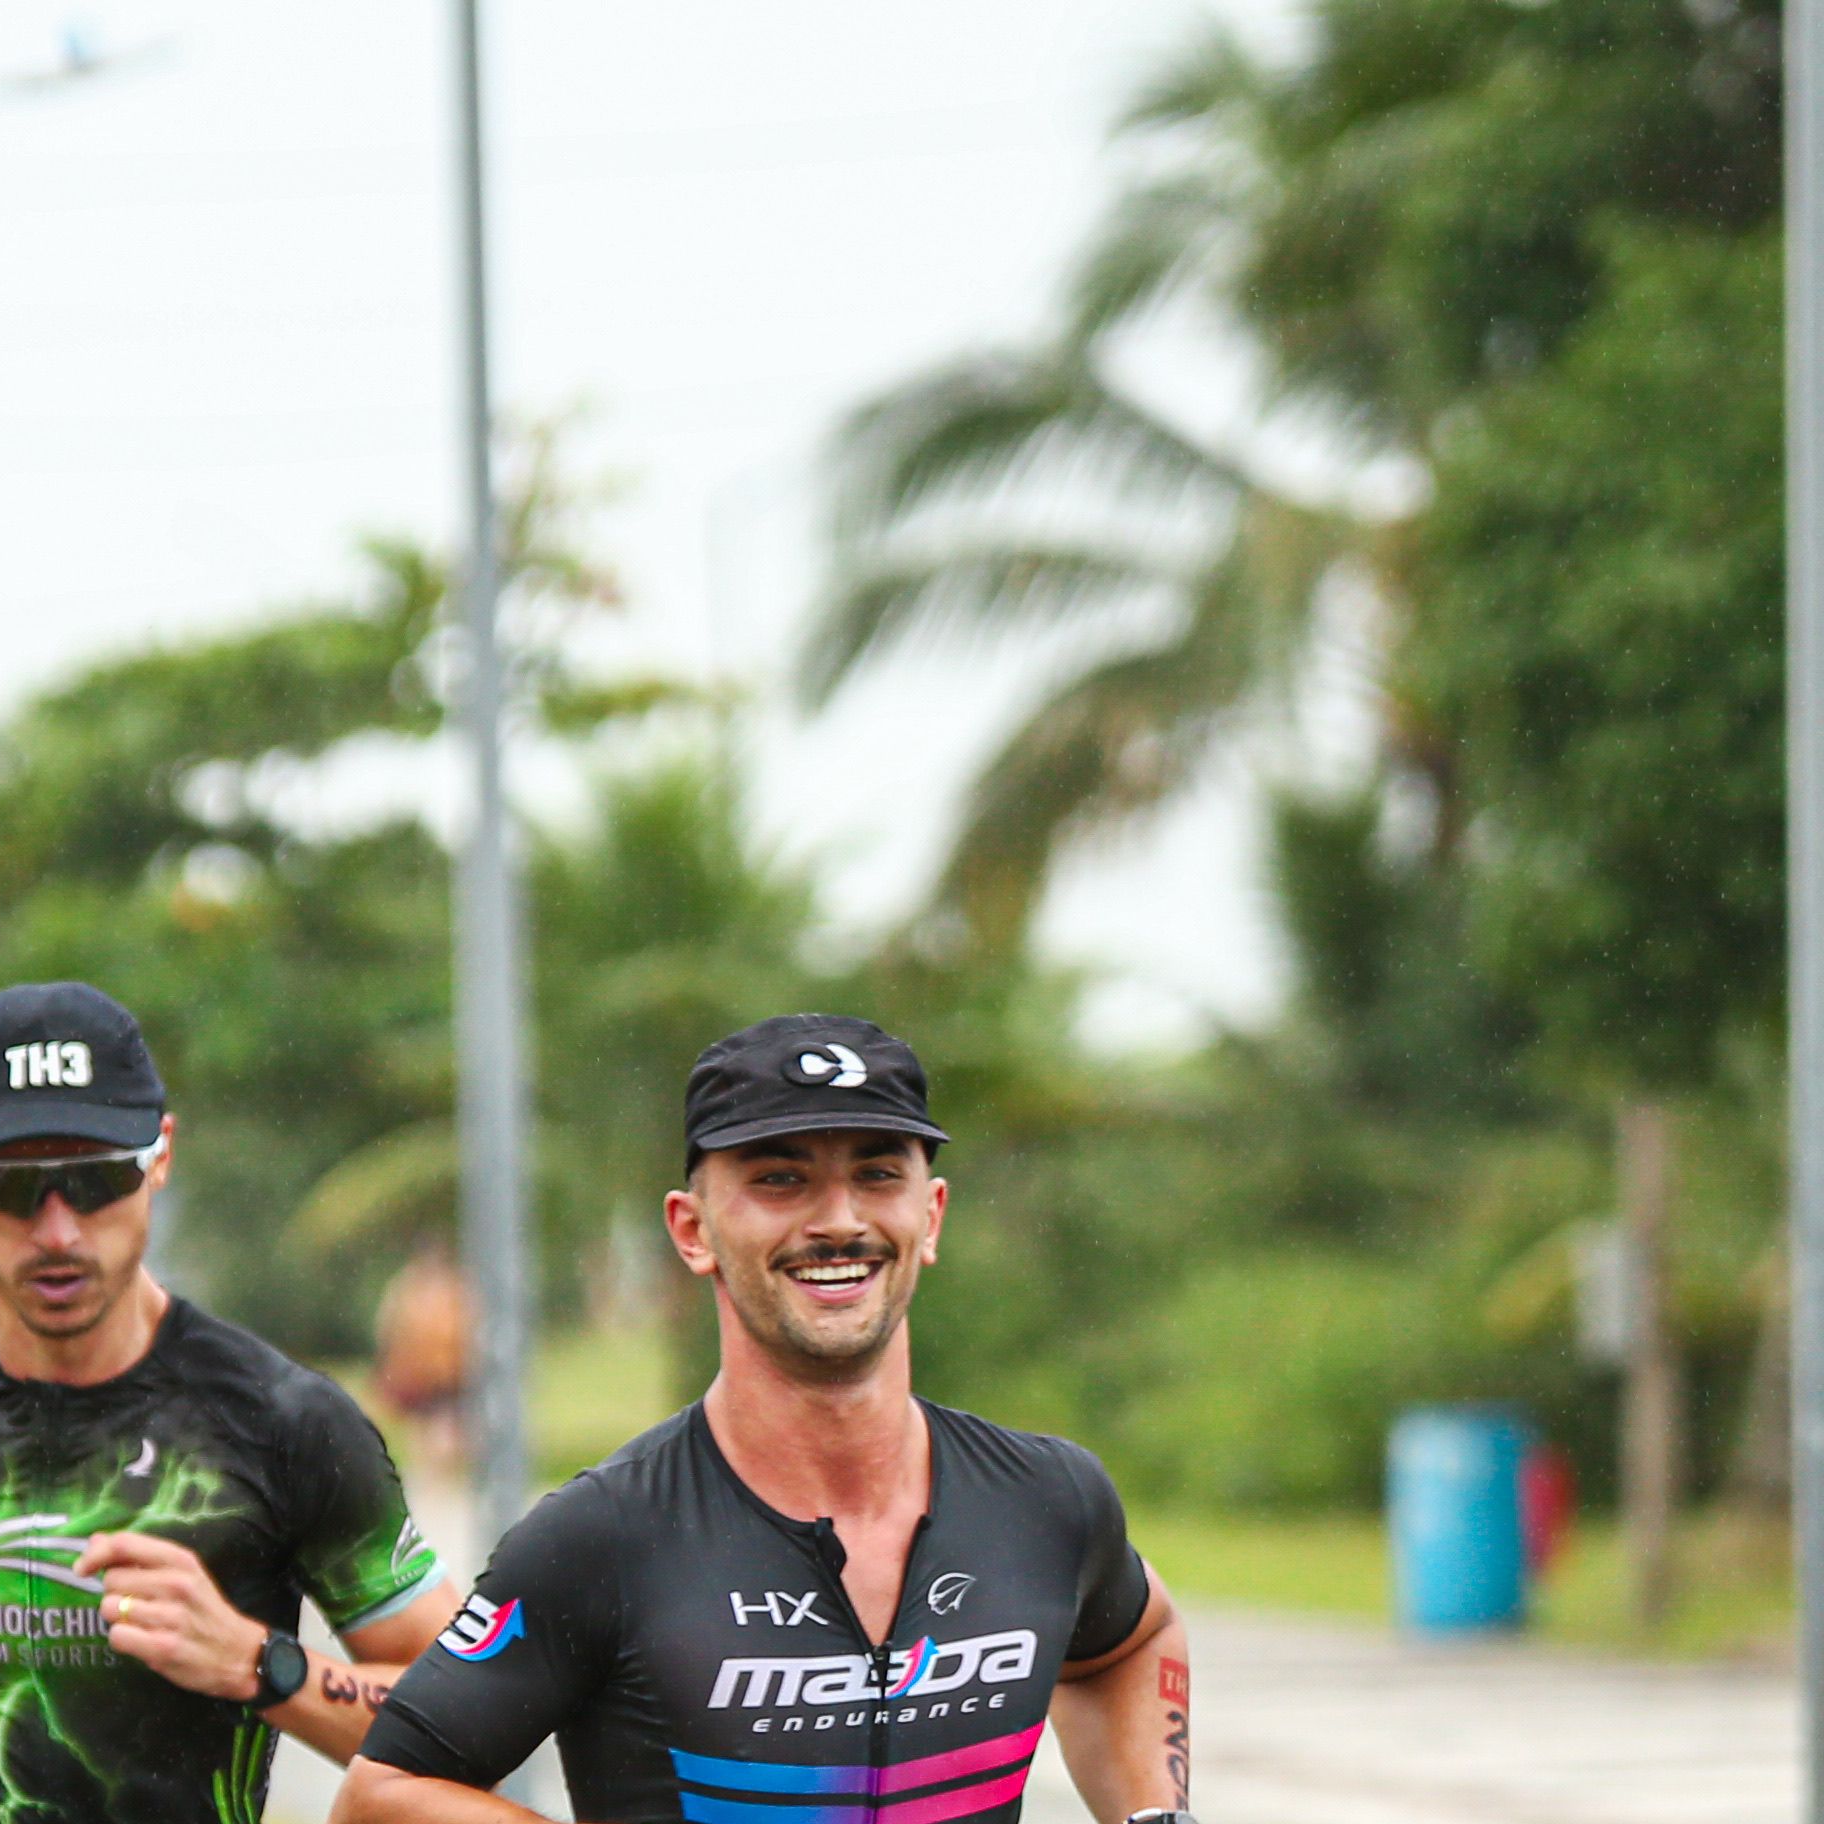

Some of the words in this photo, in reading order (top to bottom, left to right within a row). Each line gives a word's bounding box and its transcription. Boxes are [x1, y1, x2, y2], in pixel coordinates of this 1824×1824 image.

[4, 1040, 93, 1090] TH3
[729, 1591, 829, 1626] HX
[18, 1644, 117, 1668] SPORTS
